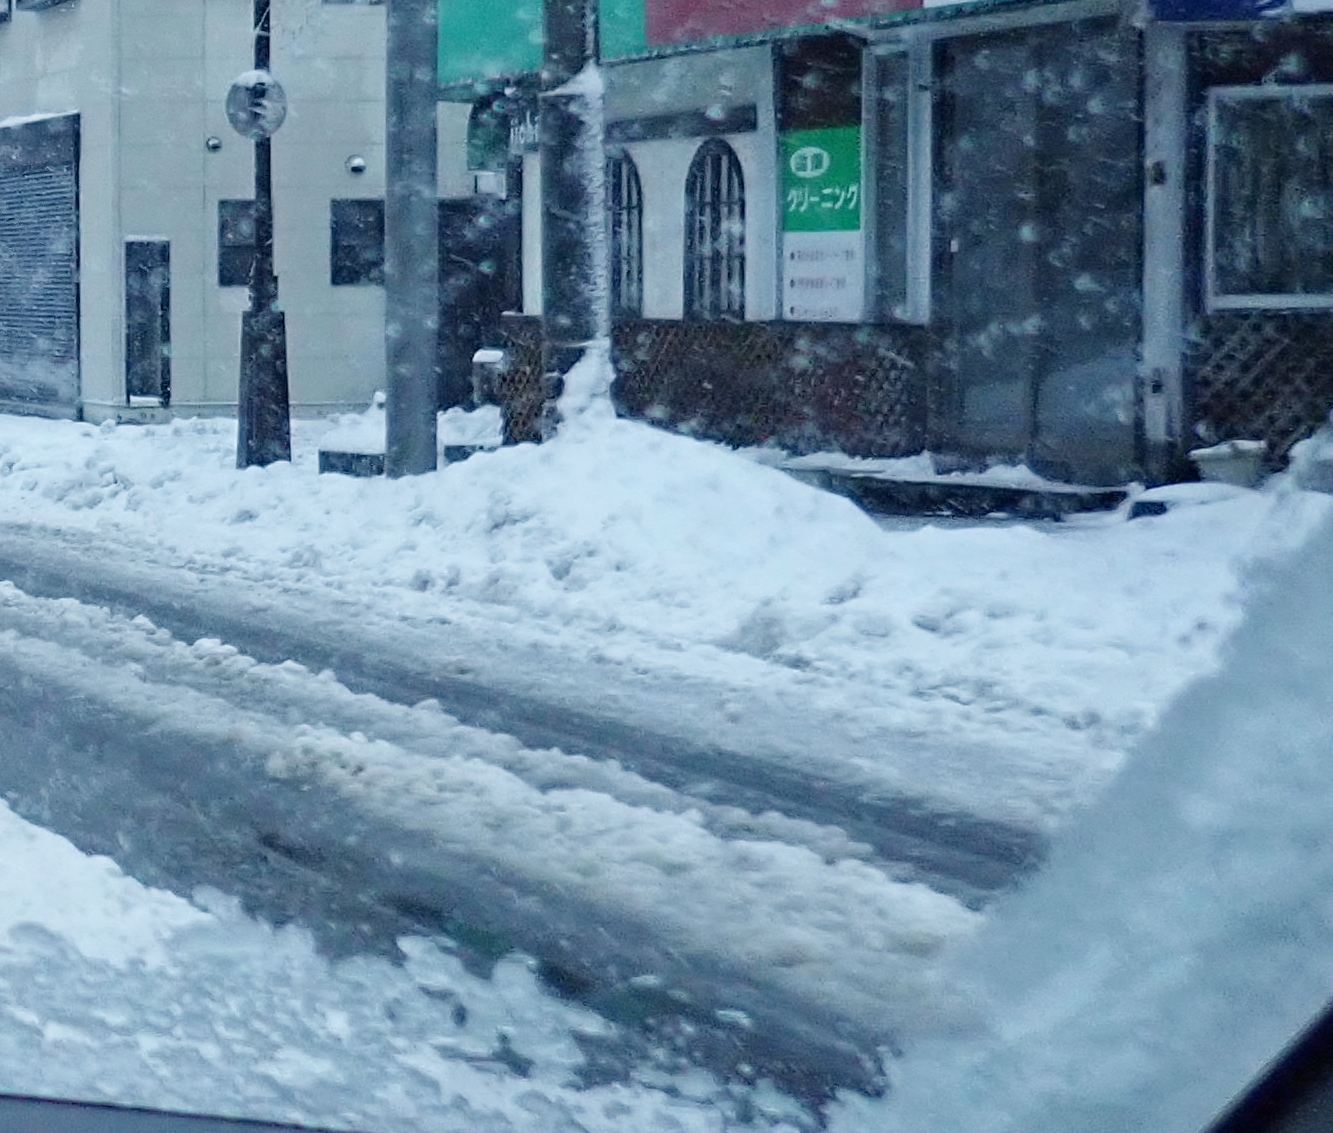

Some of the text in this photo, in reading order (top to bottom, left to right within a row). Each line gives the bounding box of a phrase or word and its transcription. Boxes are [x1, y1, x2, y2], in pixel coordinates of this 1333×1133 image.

[786, 181, 860, 213] クリーニング
